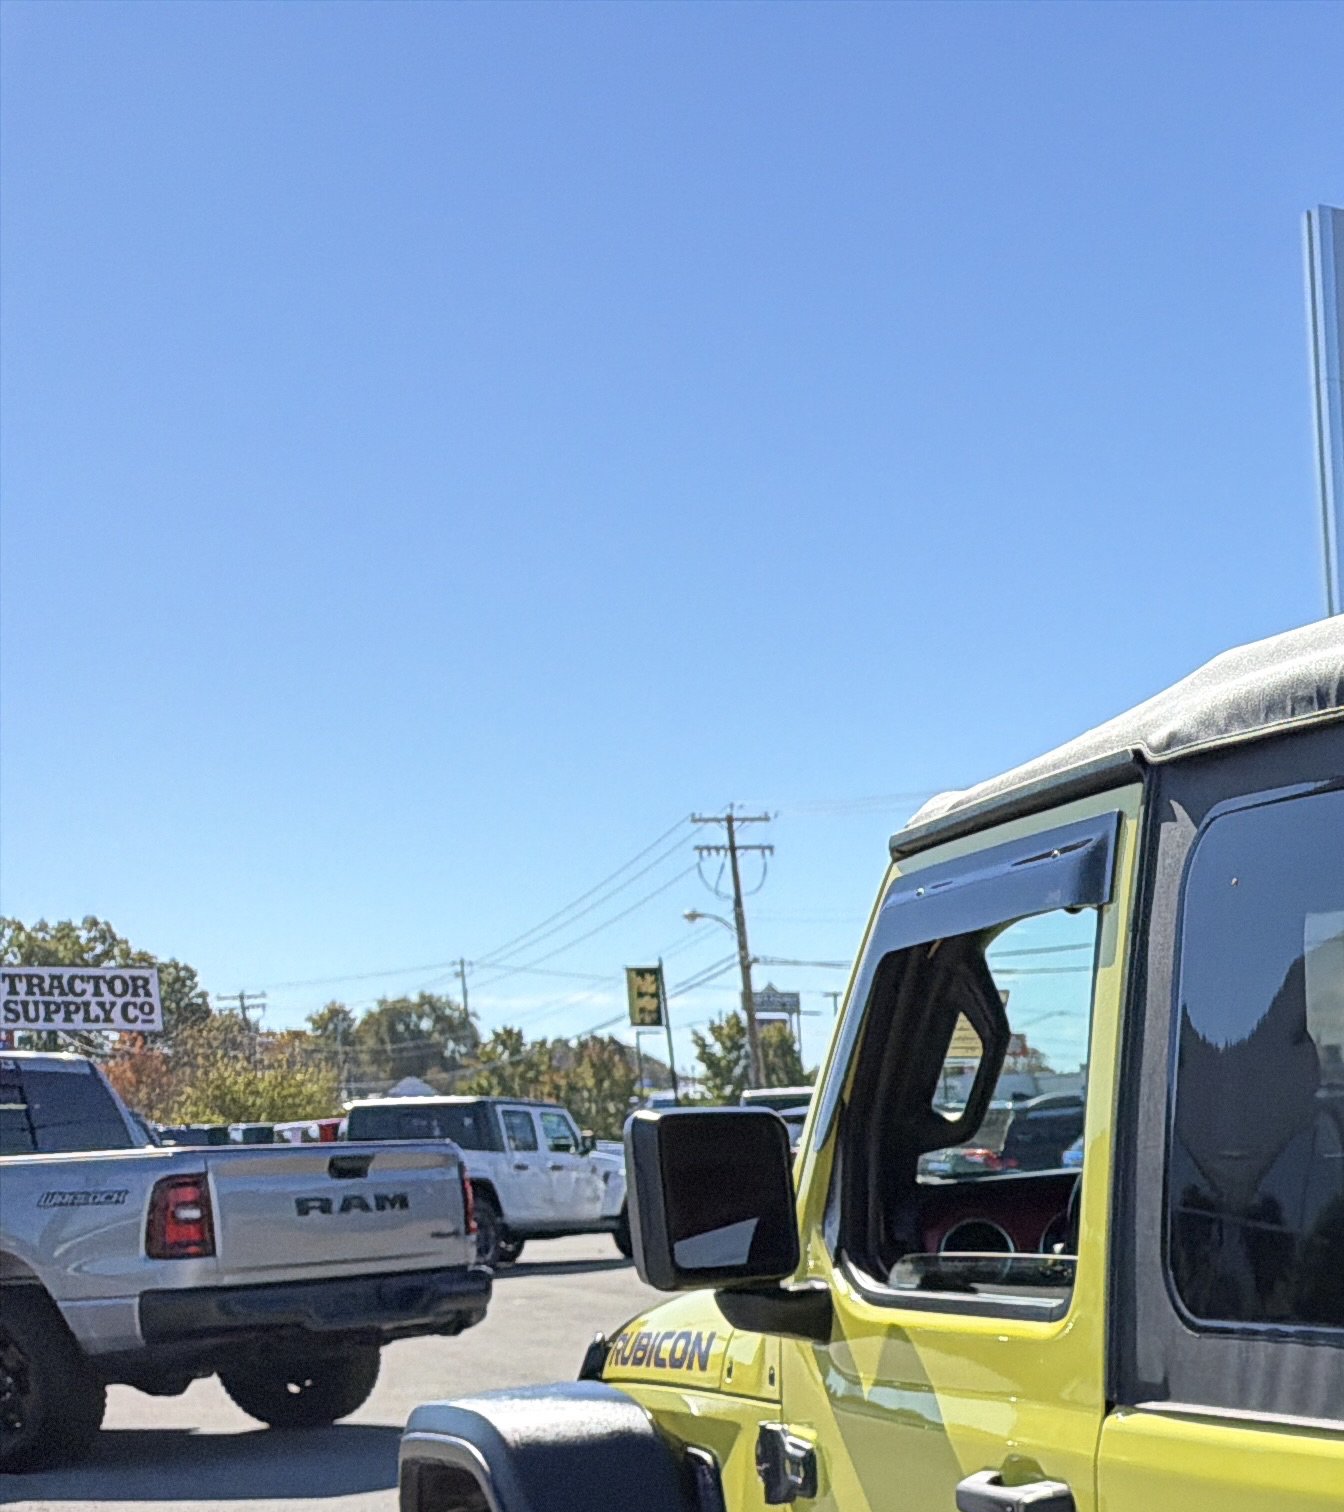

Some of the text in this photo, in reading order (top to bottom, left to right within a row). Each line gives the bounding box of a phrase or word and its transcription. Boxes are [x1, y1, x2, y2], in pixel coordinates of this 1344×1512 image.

[1, 972, 153, 999] TRACTOR
[2, 999, 117, 1024] SUPPLY
[294, 1192, 410, 1217] RAM
[608, 1330, 718, 1373] RUBICON
